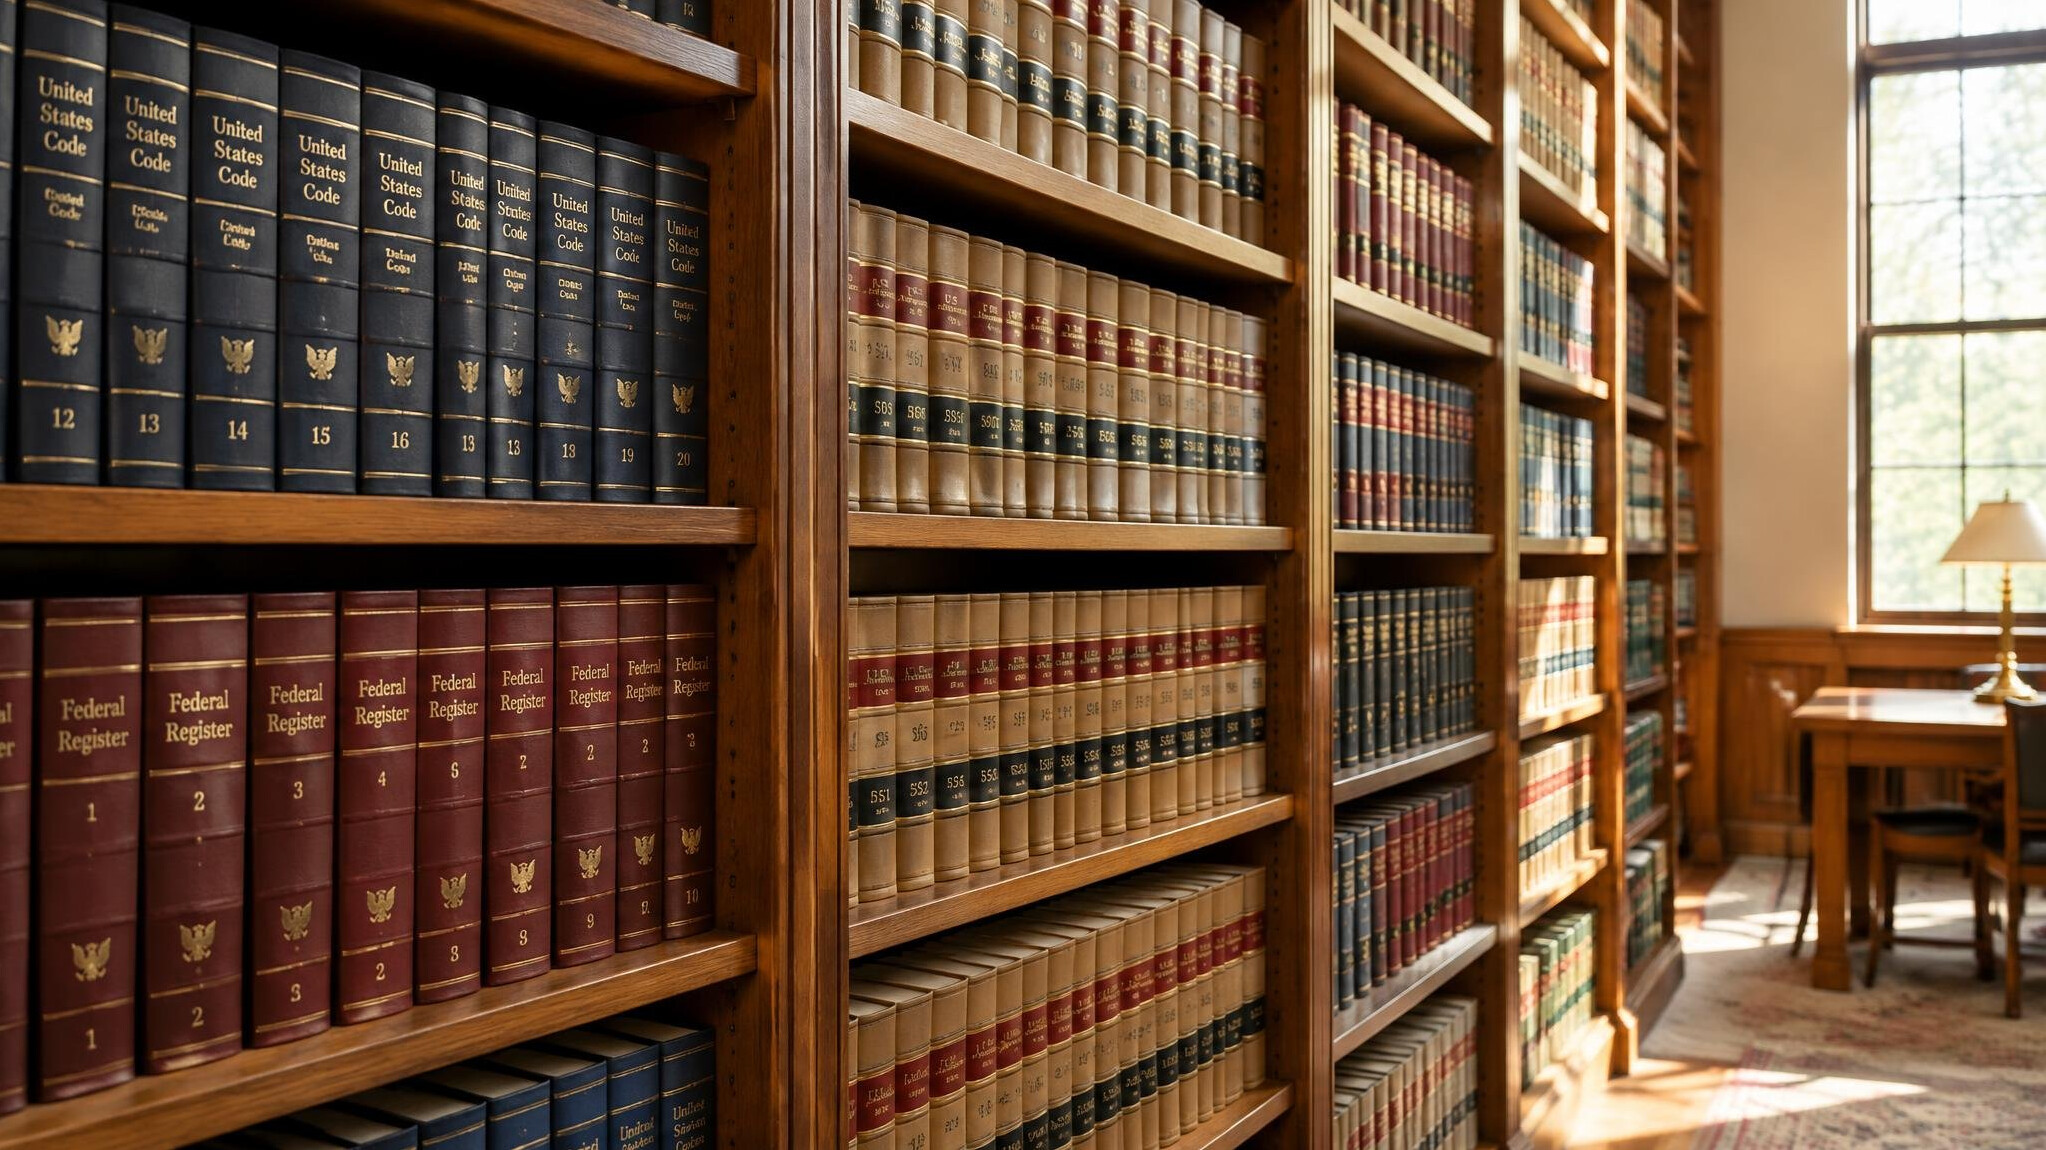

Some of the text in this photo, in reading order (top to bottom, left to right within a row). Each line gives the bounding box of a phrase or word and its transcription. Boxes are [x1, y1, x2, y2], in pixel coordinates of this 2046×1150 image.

[38, 76, 93, 106] United
[40, 103, 93, 132] States
[125, 95, 177, 124] United
[126, 120, 176, 148] States
[213, 116, 263, 143] United
[44, 131, 87, 157] Code
[214, 140, 263, 166] States
[299, 135, 346, 160] United
[131, 148, 171, 173] Code
[300, 158, 346, 183] States
[379, 153, 422, 177] United
[218, 167, 258, 189] Code
[381, 175, 422, 198] States
[451, 170, 484, 191] United
[304, 183, 340, 205] Code
[452, 191, 485, 211] States
[553, 193, 588, 214] United
[384, 199, 417, 219] Code
[611, 207, 644, 226] United
[503, 224, 528, 241] Code
[555, 213, 588, 233] States
[667, 219, 699, 239] United
[558, 234, 584, 252] Code
[612, 226, 644, 246] States
[668, 239, 699, 257] States
[672, 258, 695, 274] Code
[53, 409, 75, 429] 12
[139, 414, 160, 433] 13
[227, 420, 248, 440] 14
[311, 426, 330, 445] 15
[391, 431, 410, 449] 16
[621, 448, 634, 462] 19
[678, 452, 691, 467] 20
[571, 664, 610, 682] Federal
[627, 658, 662, 676] Federal
[358, 677, 407, 698] Federal
[431, 673, 477, 693] Federal
[502, 668, 544, 687] Federal
[169, 690, 229, 713] Federal
[270, 682, 324, 705] Federal
[569, 688, 612, 709] Register
[625, 683, 663, 703] Register
[61, 695, 126, 721] Federal
[429, 699, 479, 722] Register
[500, 693, 546, 715] Register
[267, 711, 327, 736] Register
[355, 706, 410, 729] Register
[58, 728, 129, 755] Register
[165, 720, 233, 746] Register
[587, 744, 595, 761] 2
[642, 738, 649, 753] 2
[519, 755, 527, 770] 2
[377, 771, 387, 787] 4
[293, 781, 304, 800] 3
[193, 791, 205, 811] 2
[87, 803, 97, 822] 1
[686, 888, 699, 905] 10
[586, 913, 595, 929] 9
[519, 929, 528, 946] 9
[375, 963, 386, 981] 2
[191, 1006, 205, 1027] 2
[85, 1028, 97, 1050] 1
